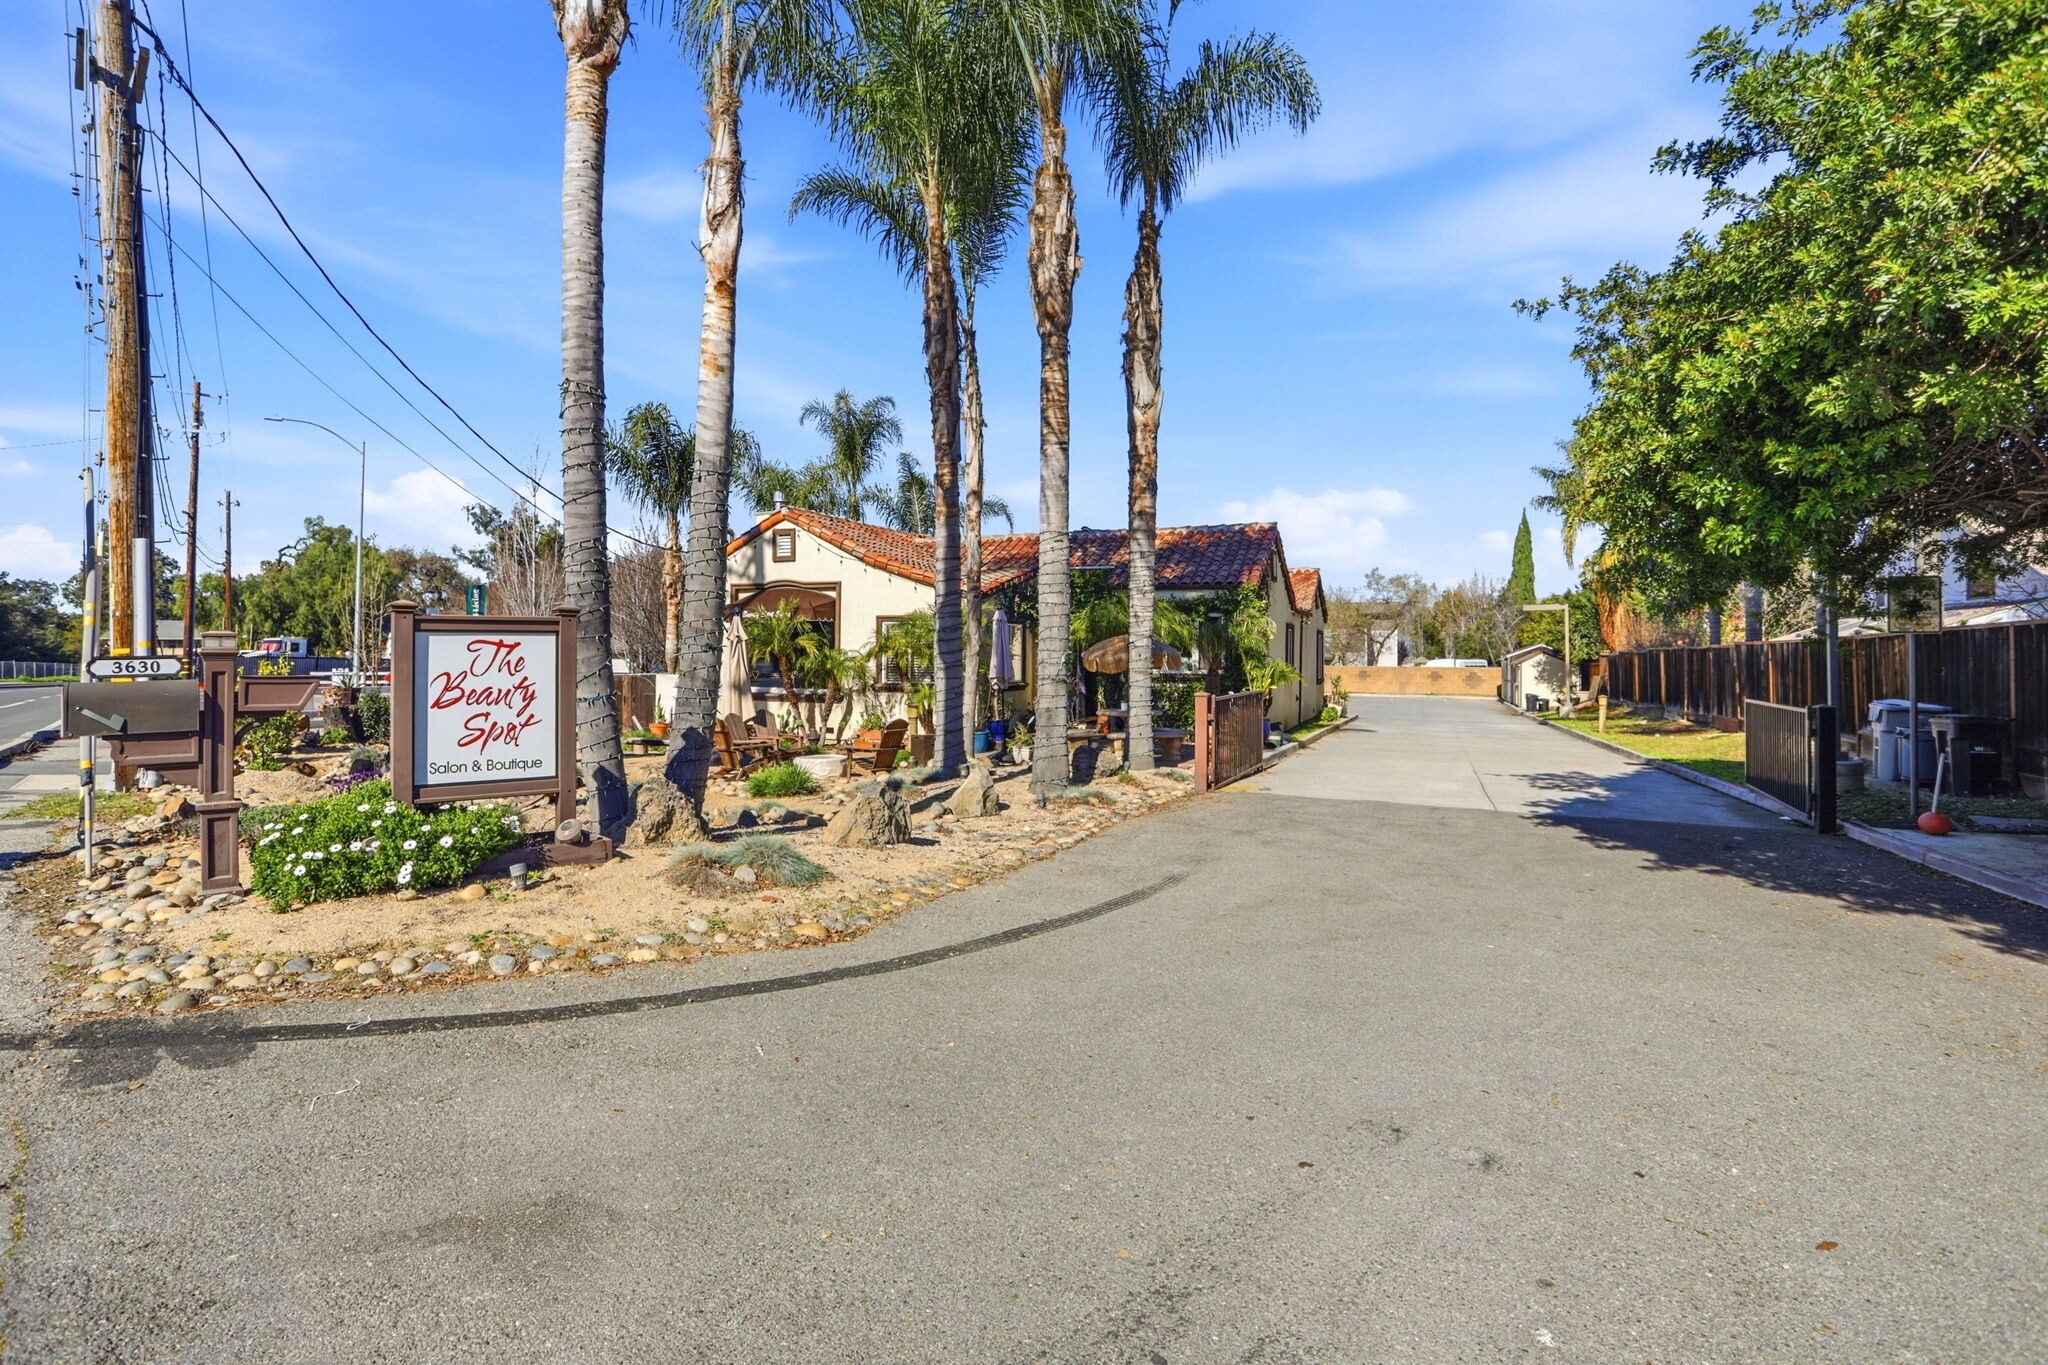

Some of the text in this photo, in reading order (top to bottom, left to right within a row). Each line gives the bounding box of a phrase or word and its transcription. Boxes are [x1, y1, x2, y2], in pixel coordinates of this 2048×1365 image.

[112, 660, 161, 674] 3630
[466, 639, 526, 677] The
[430, 671, 538, 718] Beauty
[457, 712, 543, 755] Spot
[429, 757, 543, 775] Salon & Boutique
